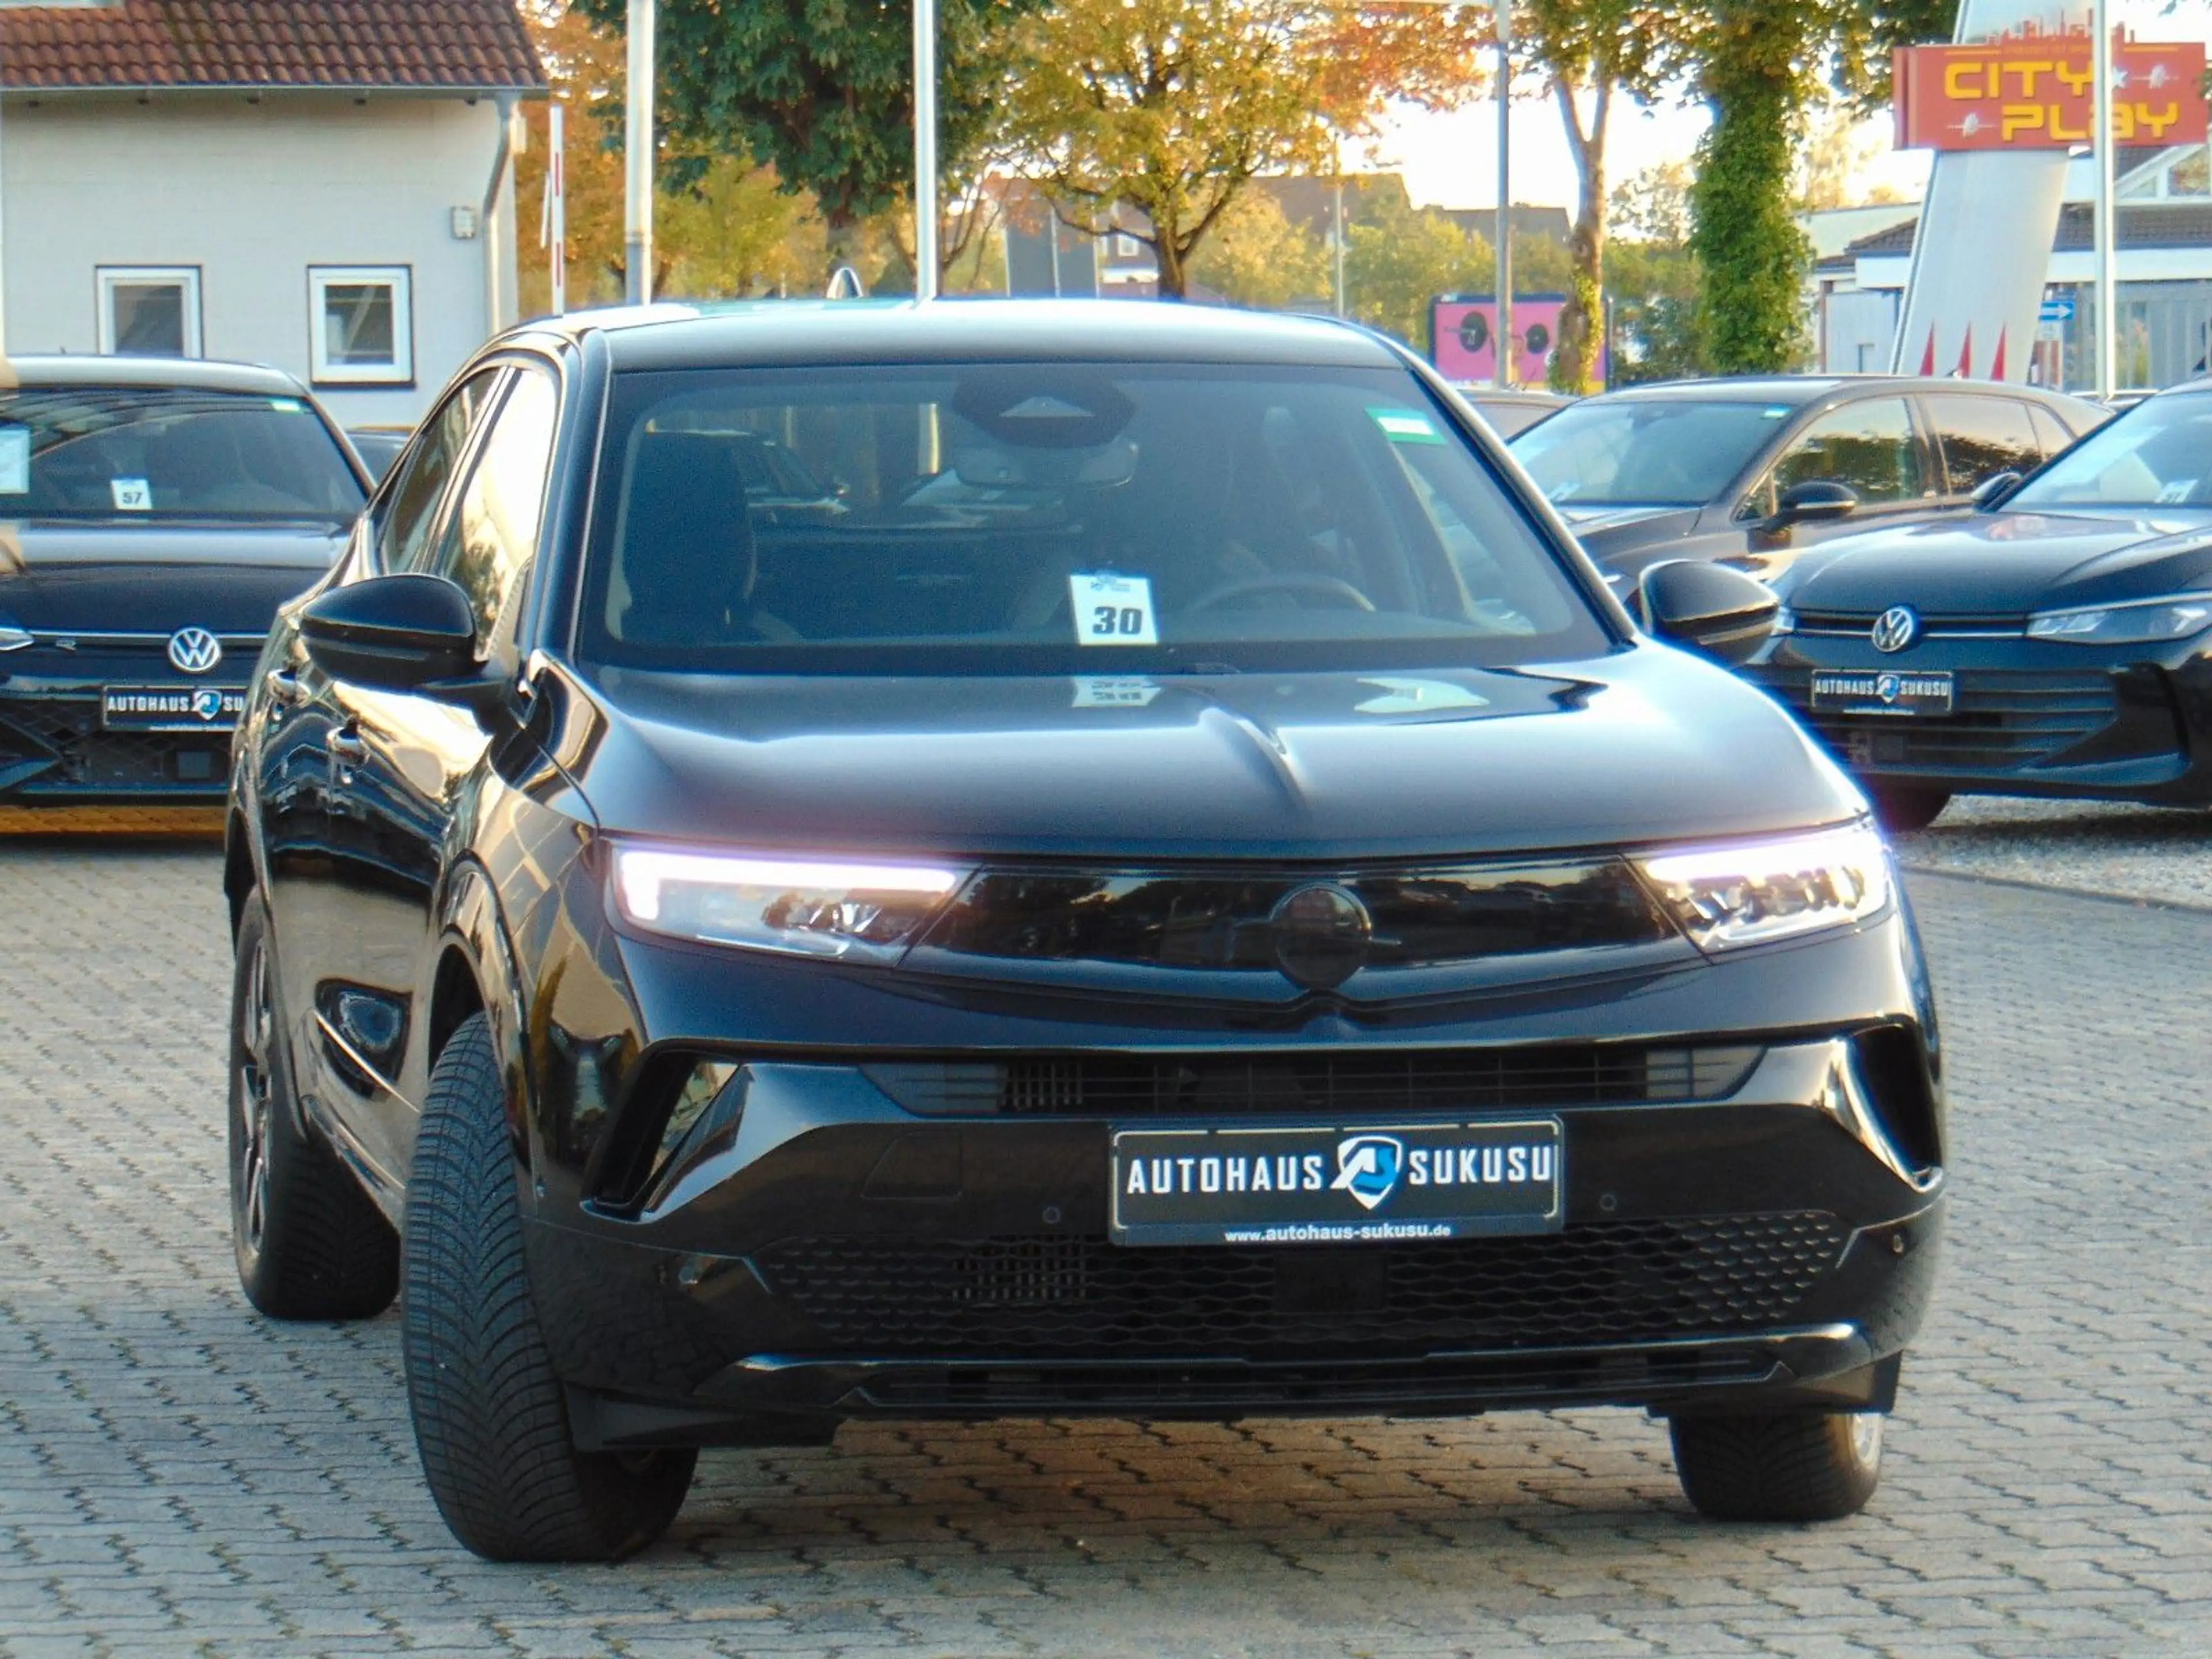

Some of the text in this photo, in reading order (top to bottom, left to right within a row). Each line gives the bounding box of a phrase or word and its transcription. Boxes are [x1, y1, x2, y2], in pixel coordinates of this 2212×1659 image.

[1945, 60, 2093, 99] CITY
[1092, 606, 1143, 635] 30
[1815, 679, 1874, 695] AUTOHAUS
[108, 695, 190, 712] AUTOHAUS
[1126, 1154, 1323, 1194] AUTOHAUS
[1408, 1146, 1551, 1185] SUKUSU
[1224, 1222, 1452, 1242] www.autohaus-sukusu.de
